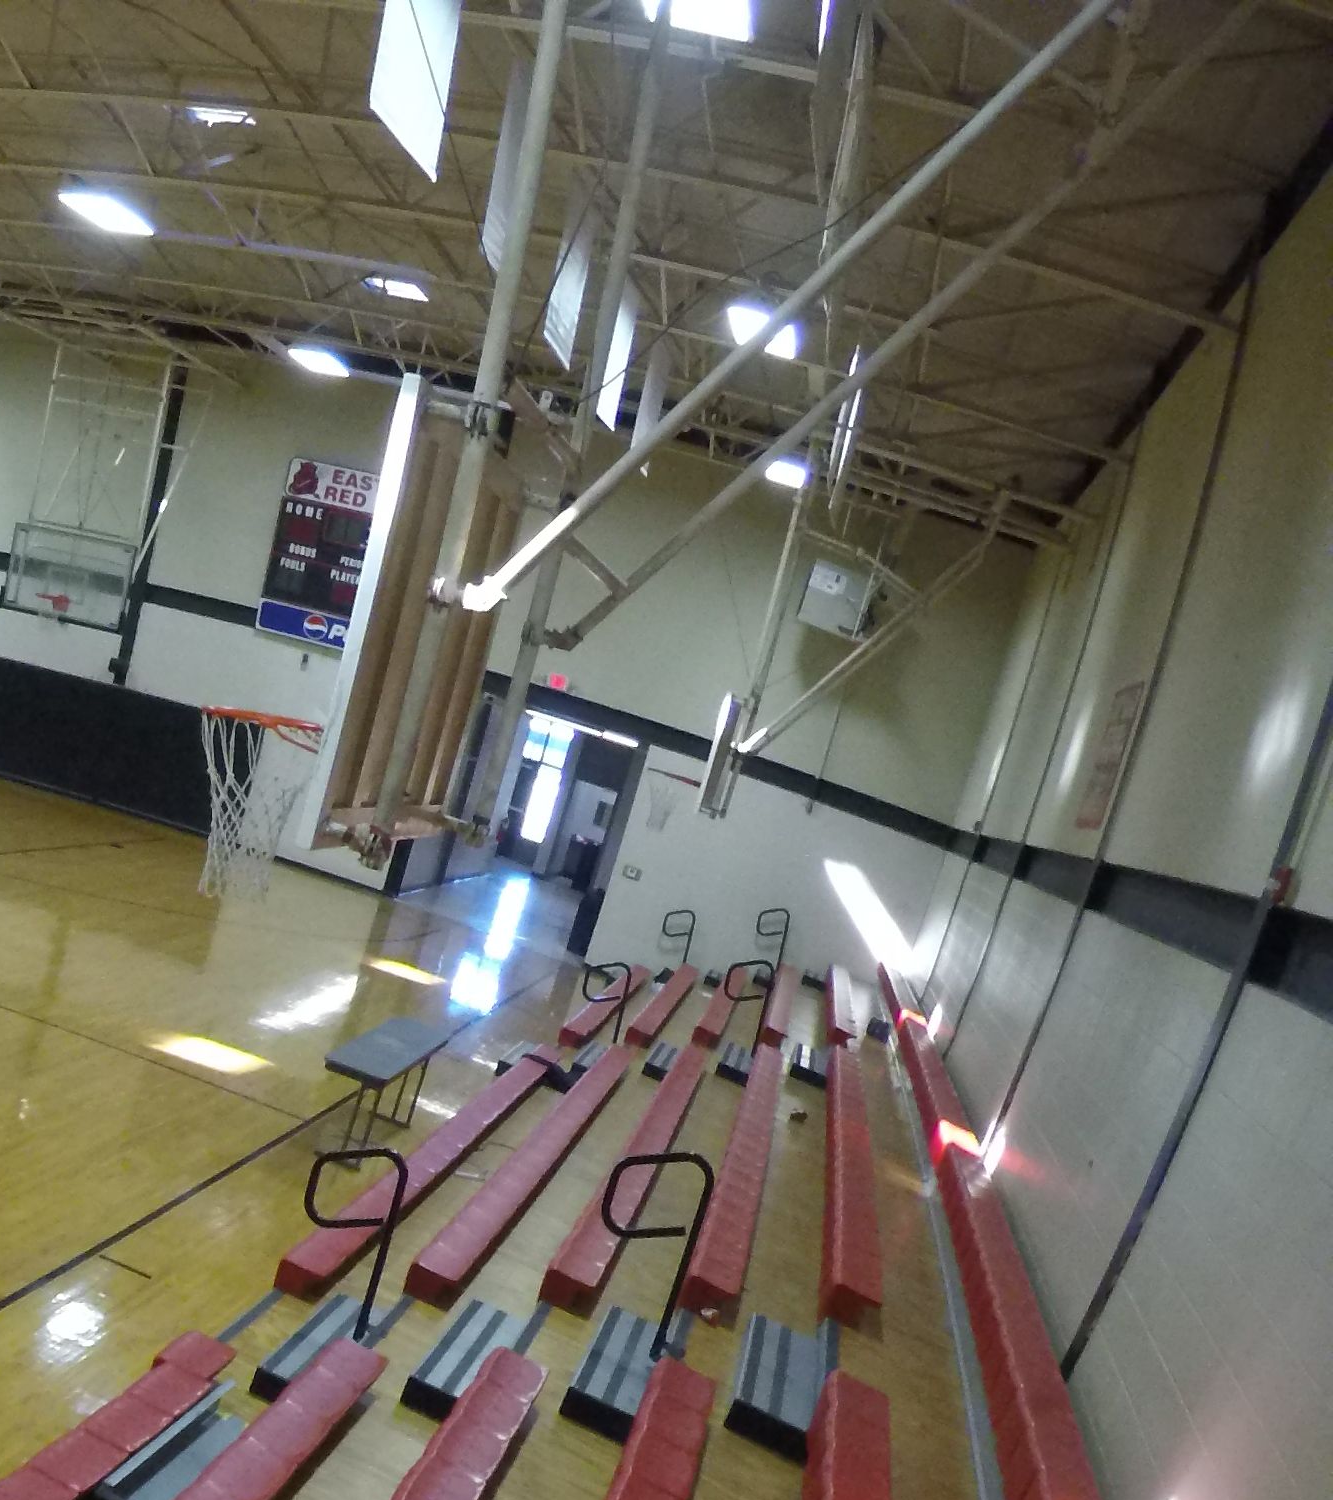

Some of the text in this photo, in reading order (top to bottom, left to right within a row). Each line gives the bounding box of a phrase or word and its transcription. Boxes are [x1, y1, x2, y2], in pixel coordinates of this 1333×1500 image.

[332, 468, 380, 492] EAS
[324, 486, 367, 508] RED
[286, 501, 324, 520] HOME
[289, 542, 317, 559] BONUS
[279, 556, 306, 572] FOULS
[339, 555, 364, 569] PERIO
